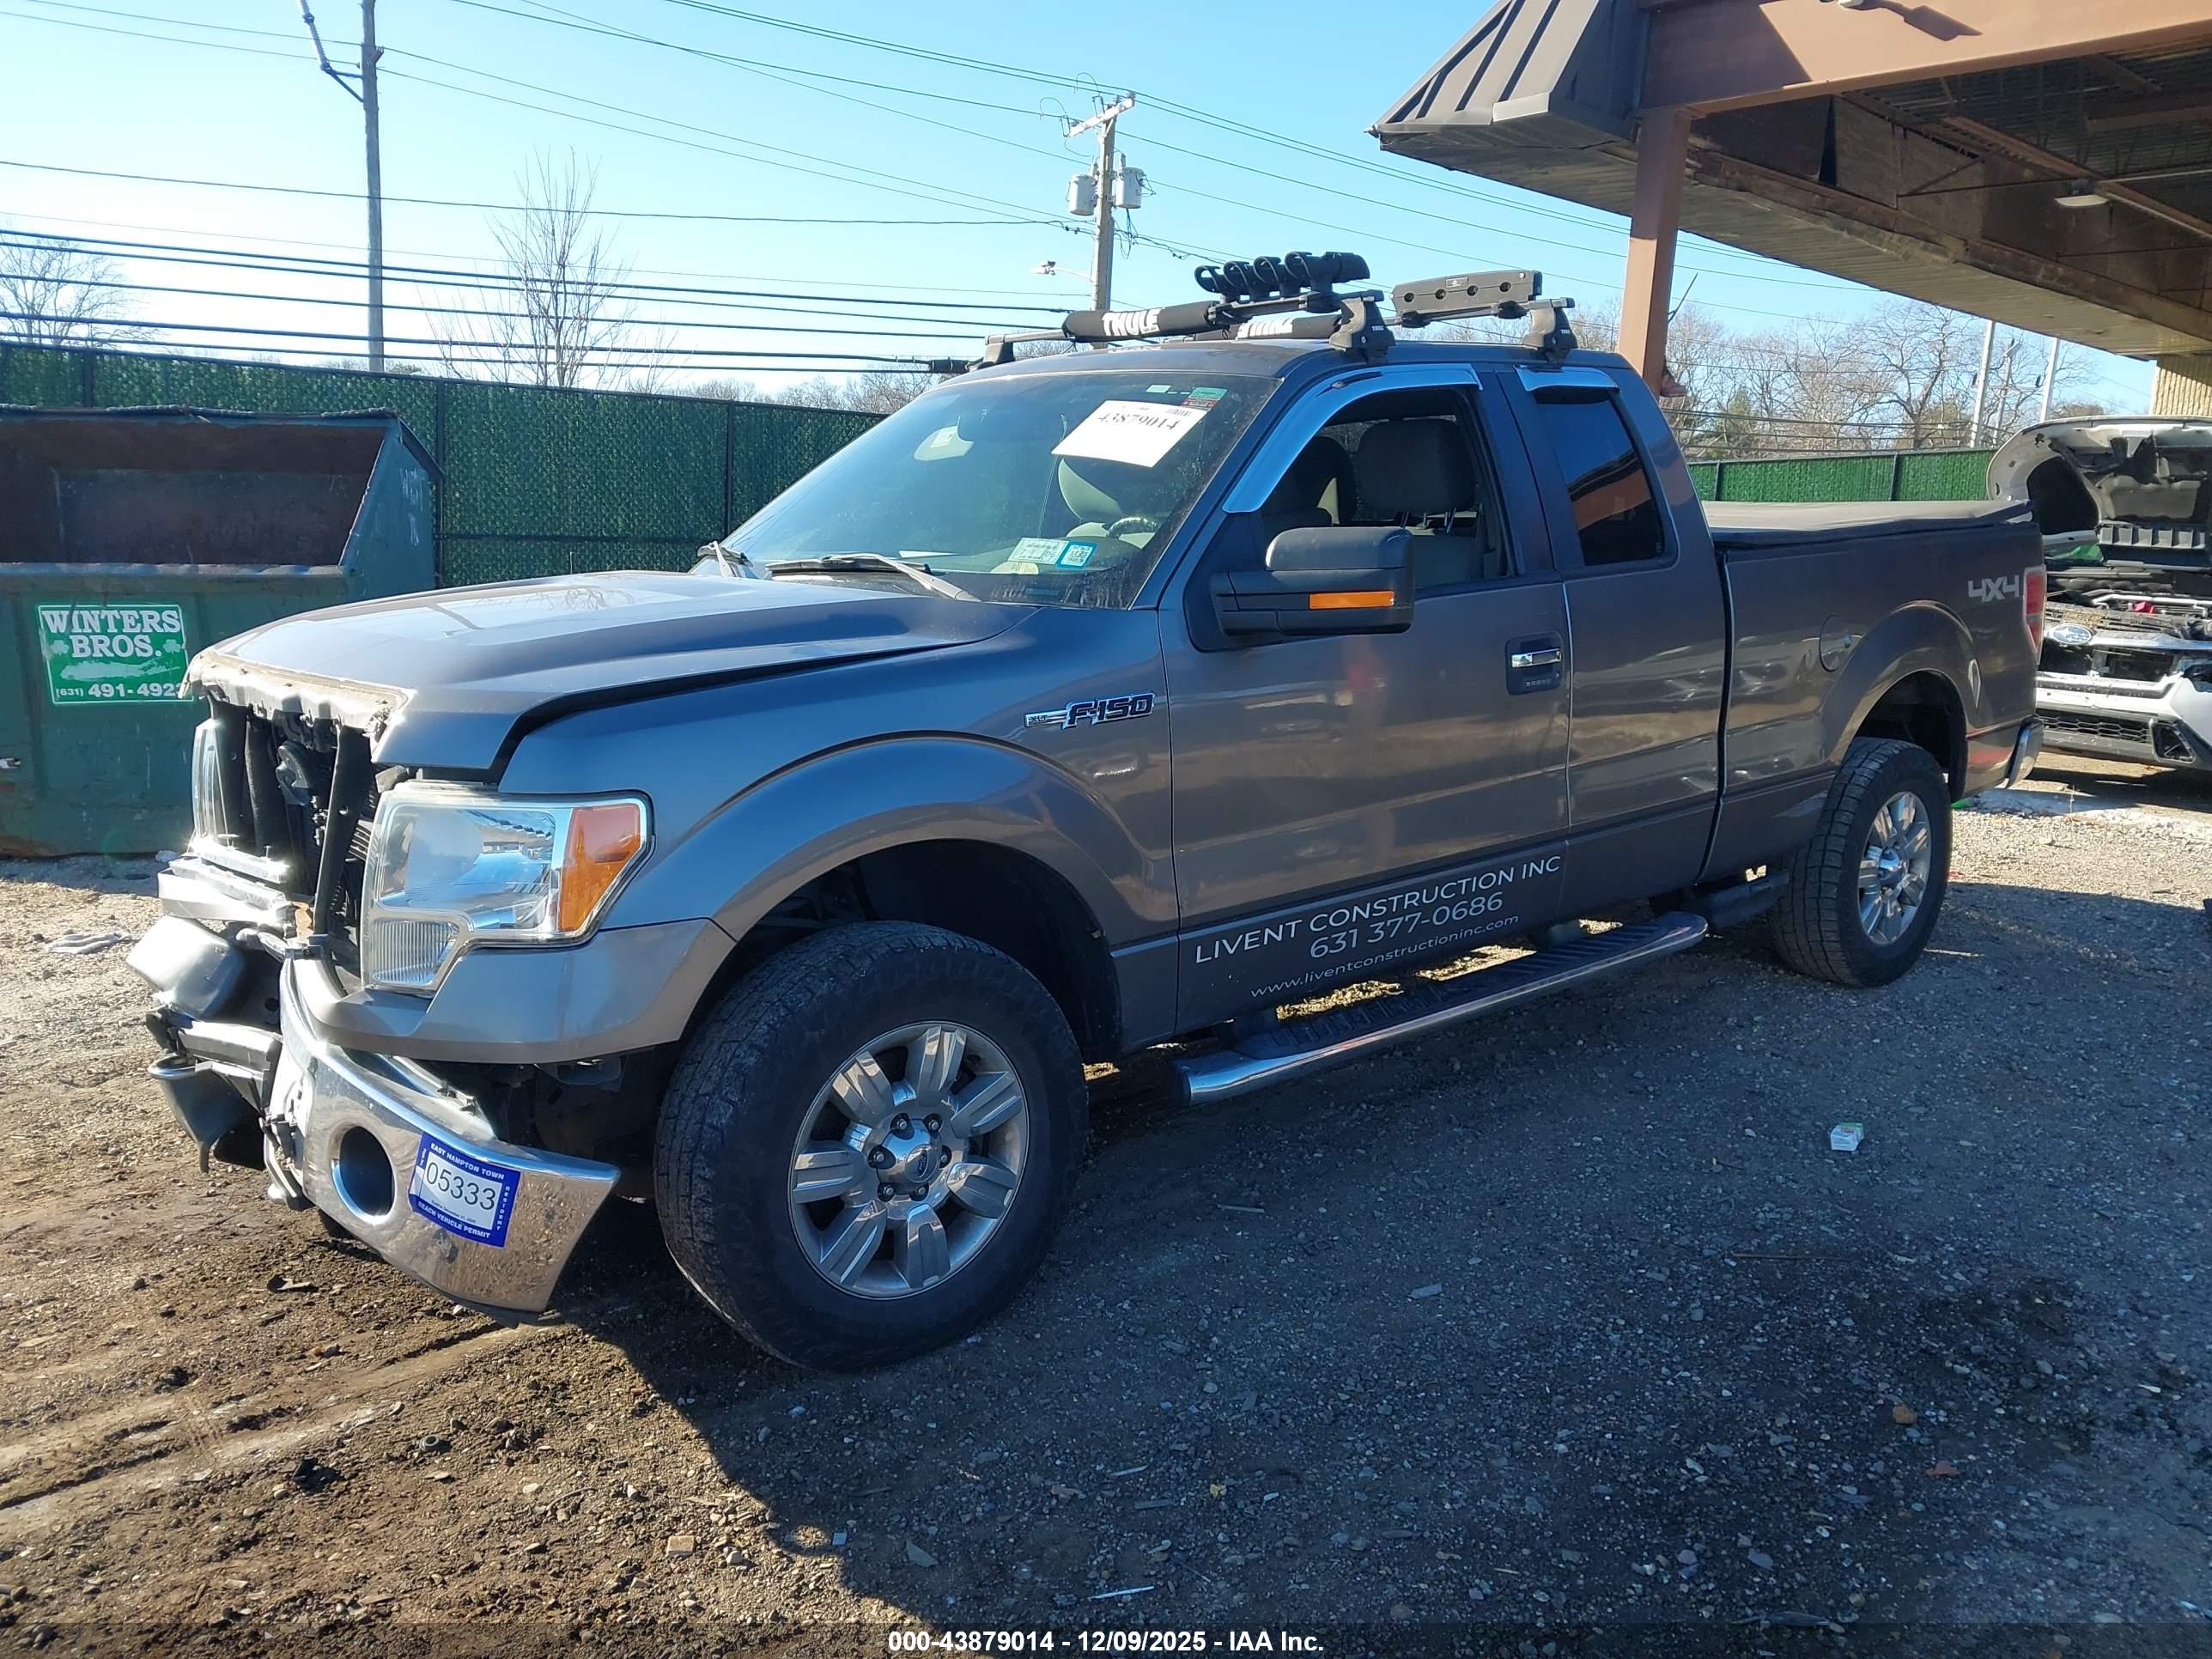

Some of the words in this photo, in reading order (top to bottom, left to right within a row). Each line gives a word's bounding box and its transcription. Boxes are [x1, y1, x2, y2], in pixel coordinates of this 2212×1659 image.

[1102, 307, 1162, 336] THULE
[41, 610, 181, 633] WINTERS
[69, 635, 162, 658] BROS.
[56, 688, 83, 697] (631)
[1062, 691, 1155, 729] F-150
[1196, 920, 1303, 963] LIVENT
[1310, 866, 1515, 933] CONSTRUCTION
[1522, 856, 1561, 879] INC
[1310, 928, 1358, 958] 631
[1367, 891, 1504, 943] 377-0686
[1251, 914, 1519, 998] www.liventconstructioninc.com
[430, 1142, 447, 1156] EAST
[447, 1153, 479, 1172] HAMPTON
[481, 1168, 505, 1180] TOWN
[426, 1162, 496, 1210] 05333
[418, 1200, 437, 1217] BEACH
[436, 1212, 463, 1230] VEHICLE
[463, 1225, 490, 1239] PERMIT
